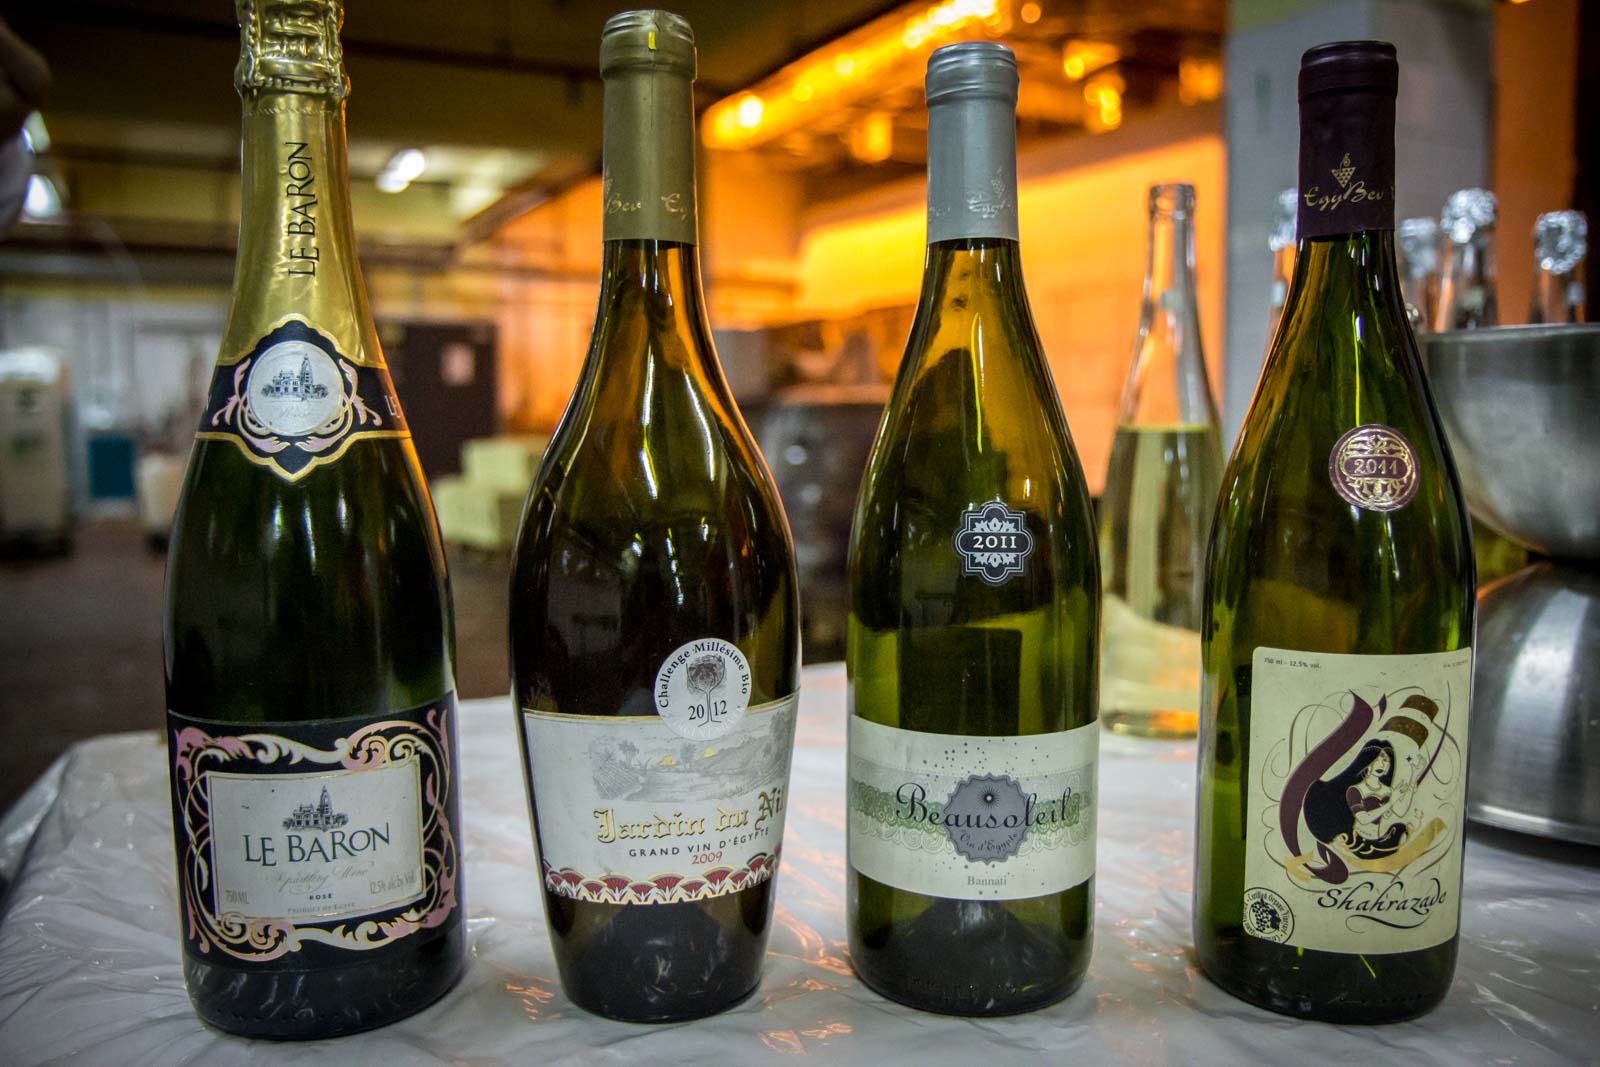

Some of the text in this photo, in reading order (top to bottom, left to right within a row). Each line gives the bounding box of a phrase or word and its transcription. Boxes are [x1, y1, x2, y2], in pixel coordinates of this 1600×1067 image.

[285, 142, 320, 276] LE BARON
[1353, 459, 1398, 475] 2011
[973, 535, 1017, 549] 2011
[658, 642, 750, 708] Challenge Millésime Bio
[688, 700, 728, 720] 20 12
[593, 806, 705, 844] Jardin
[715, 803, 749, 832] du
[896, 782, 1073, 829] Beausoleil
[243, 822, 390, 867] LE BARON
[628, 846, 680, 857] GRAND
[688, 843, 711, 853] VIN
[691, 851, 723, 865] 2009
[1317, 877, 1447, 916] Shahrazade
